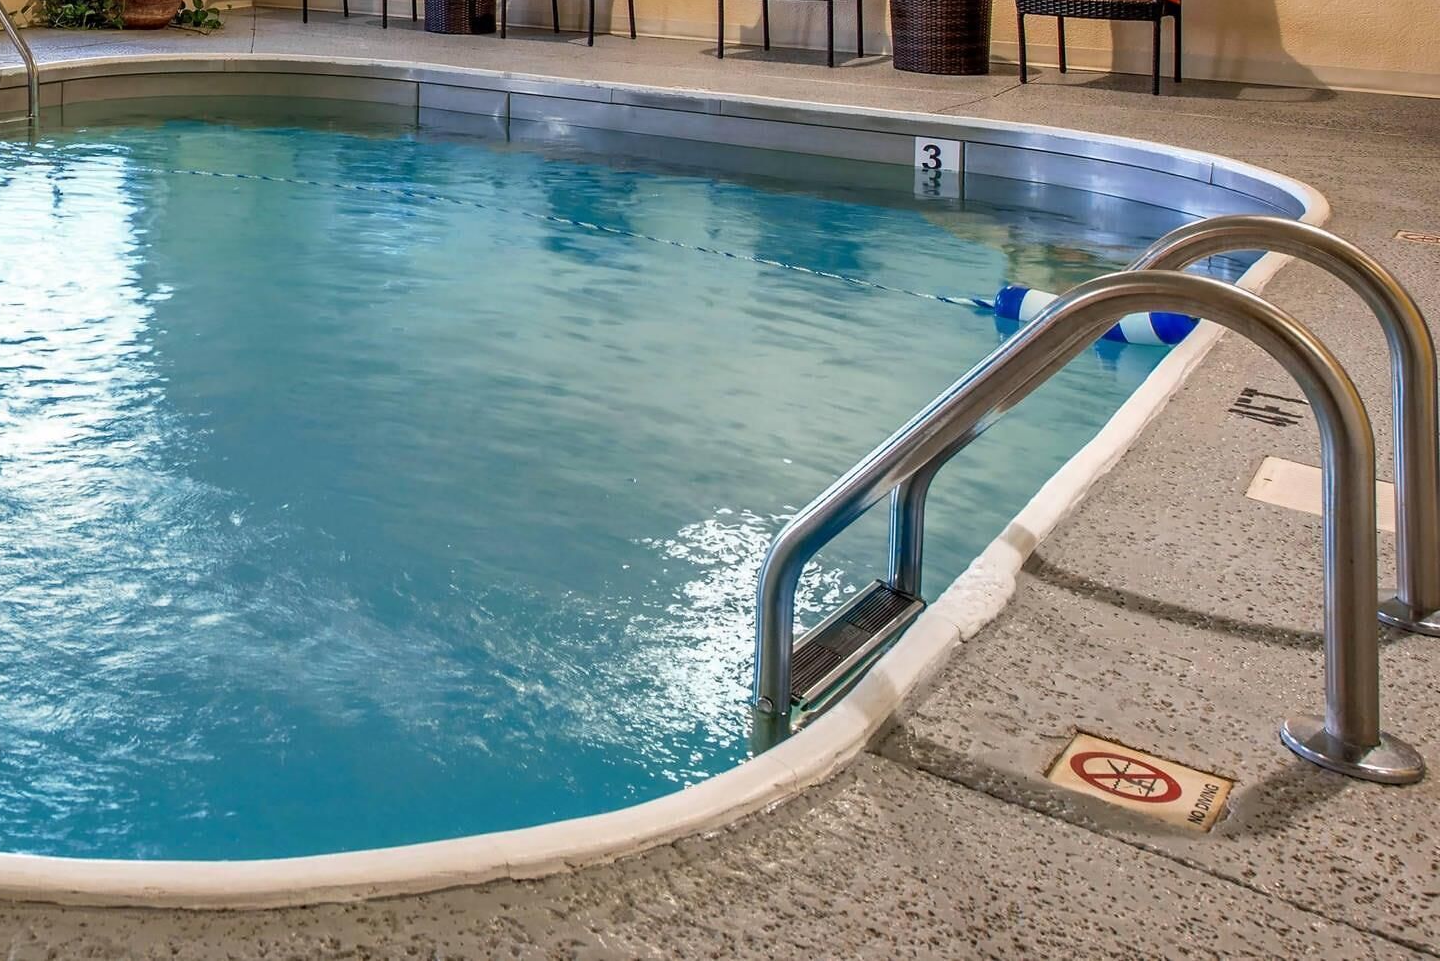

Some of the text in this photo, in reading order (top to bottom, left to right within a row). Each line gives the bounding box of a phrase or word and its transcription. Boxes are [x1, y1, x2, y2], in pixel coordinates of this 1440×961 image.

[922, 144, 942, 169] 3
[1187, 783, 1220, 825] NO DIVING
